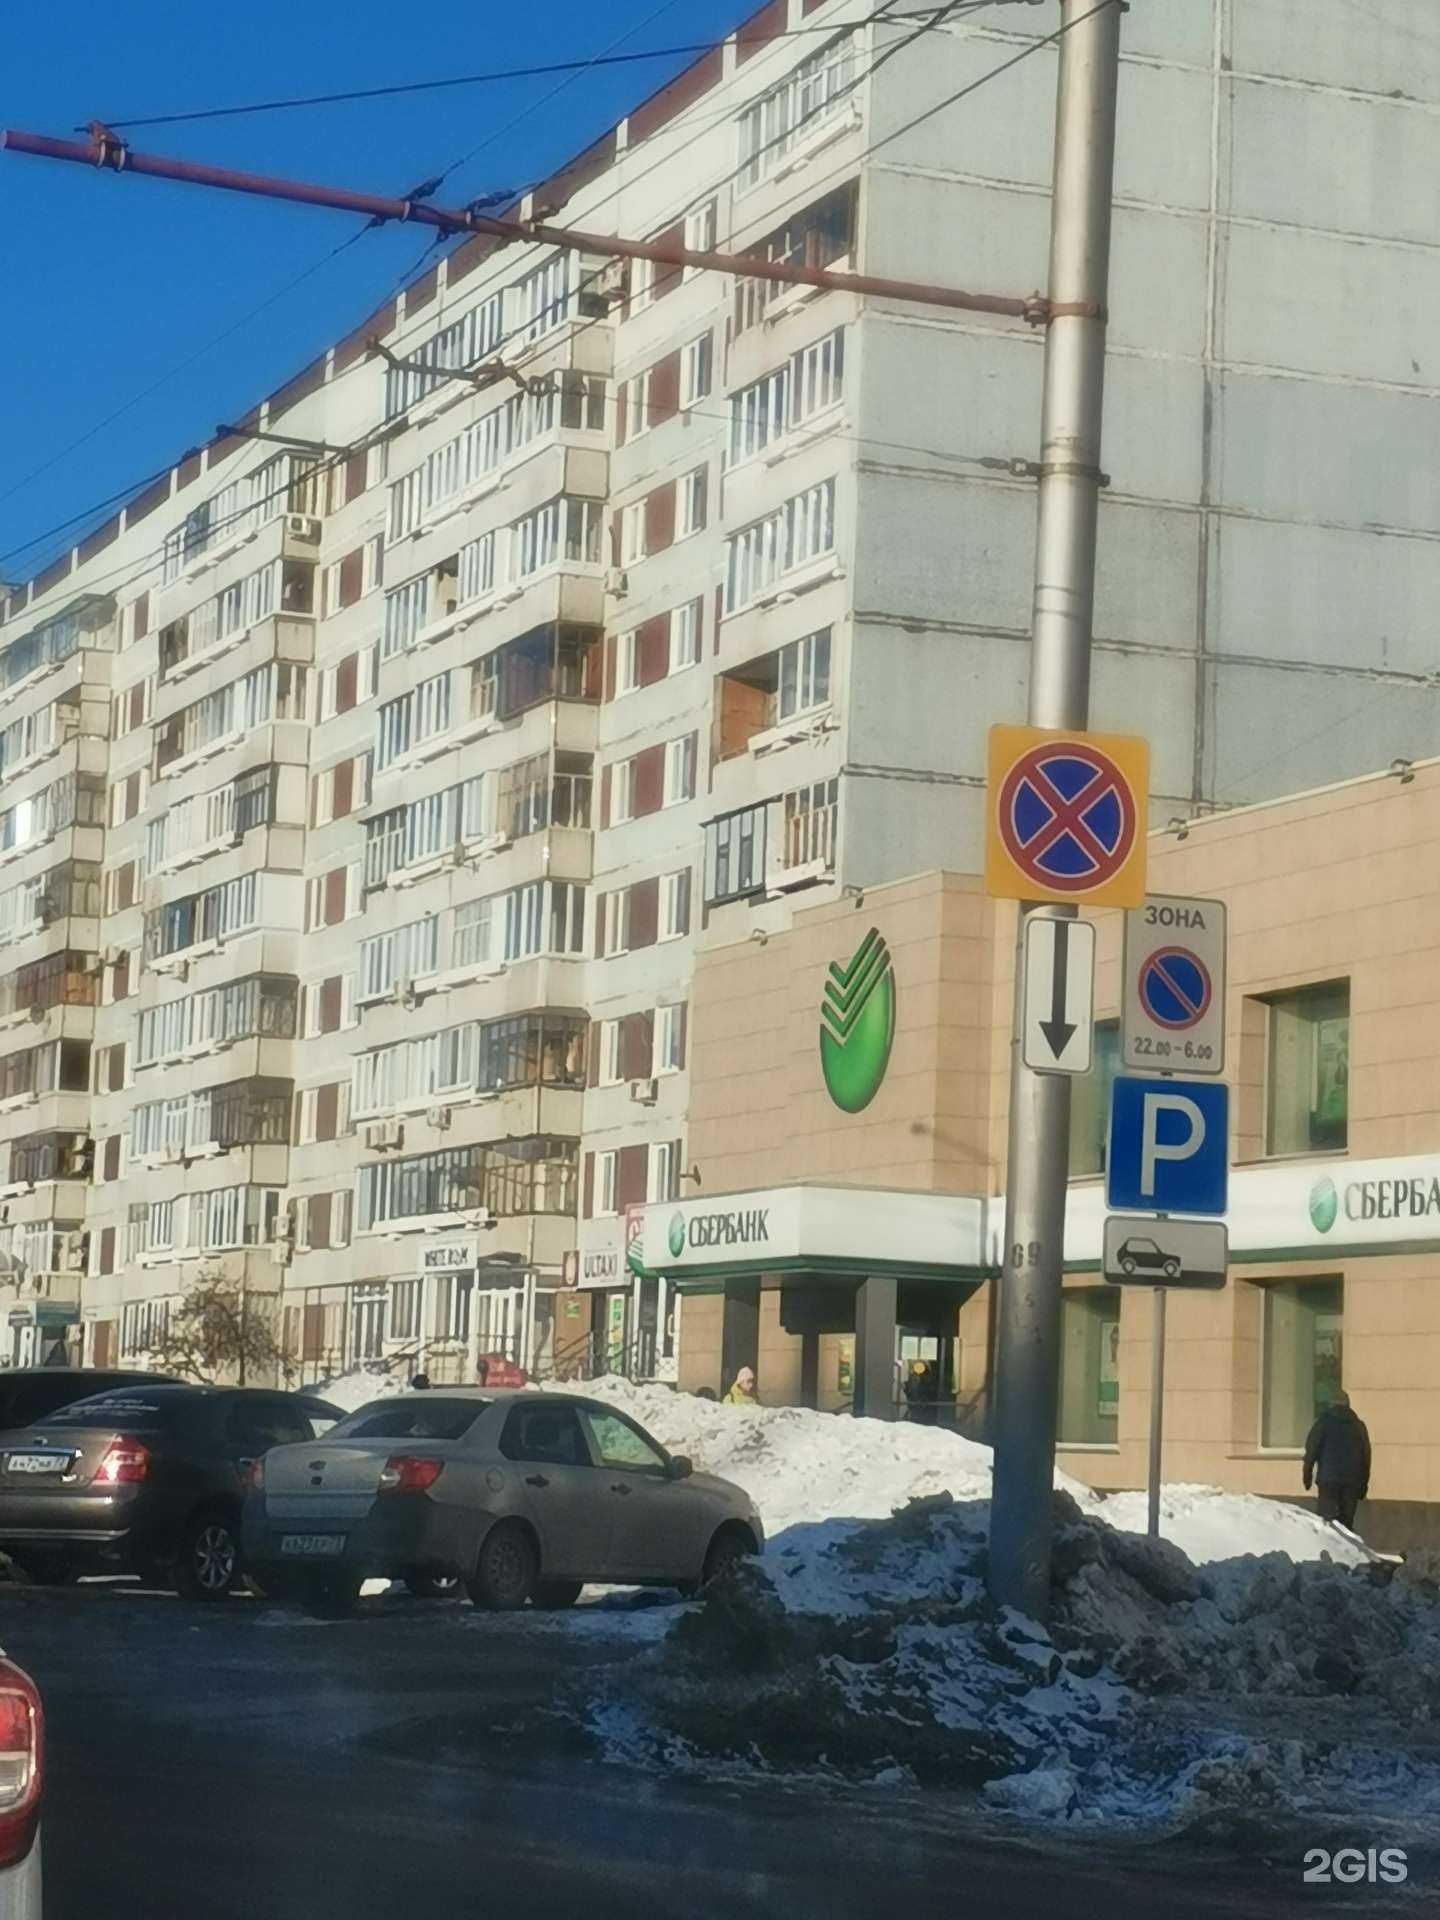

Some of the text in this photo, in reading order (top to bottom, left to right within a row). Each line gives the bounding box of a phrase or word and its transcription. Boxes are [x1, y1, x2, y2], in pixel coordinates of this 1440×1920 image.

[1144, 905, 1206, 930] ЗОНА
[1141, 1093, 1206, 1196] P
[1344, 1177, 1440, 1222] СБЕРБА
[689, 1208, 770, 1247] СБЕРБАНК
